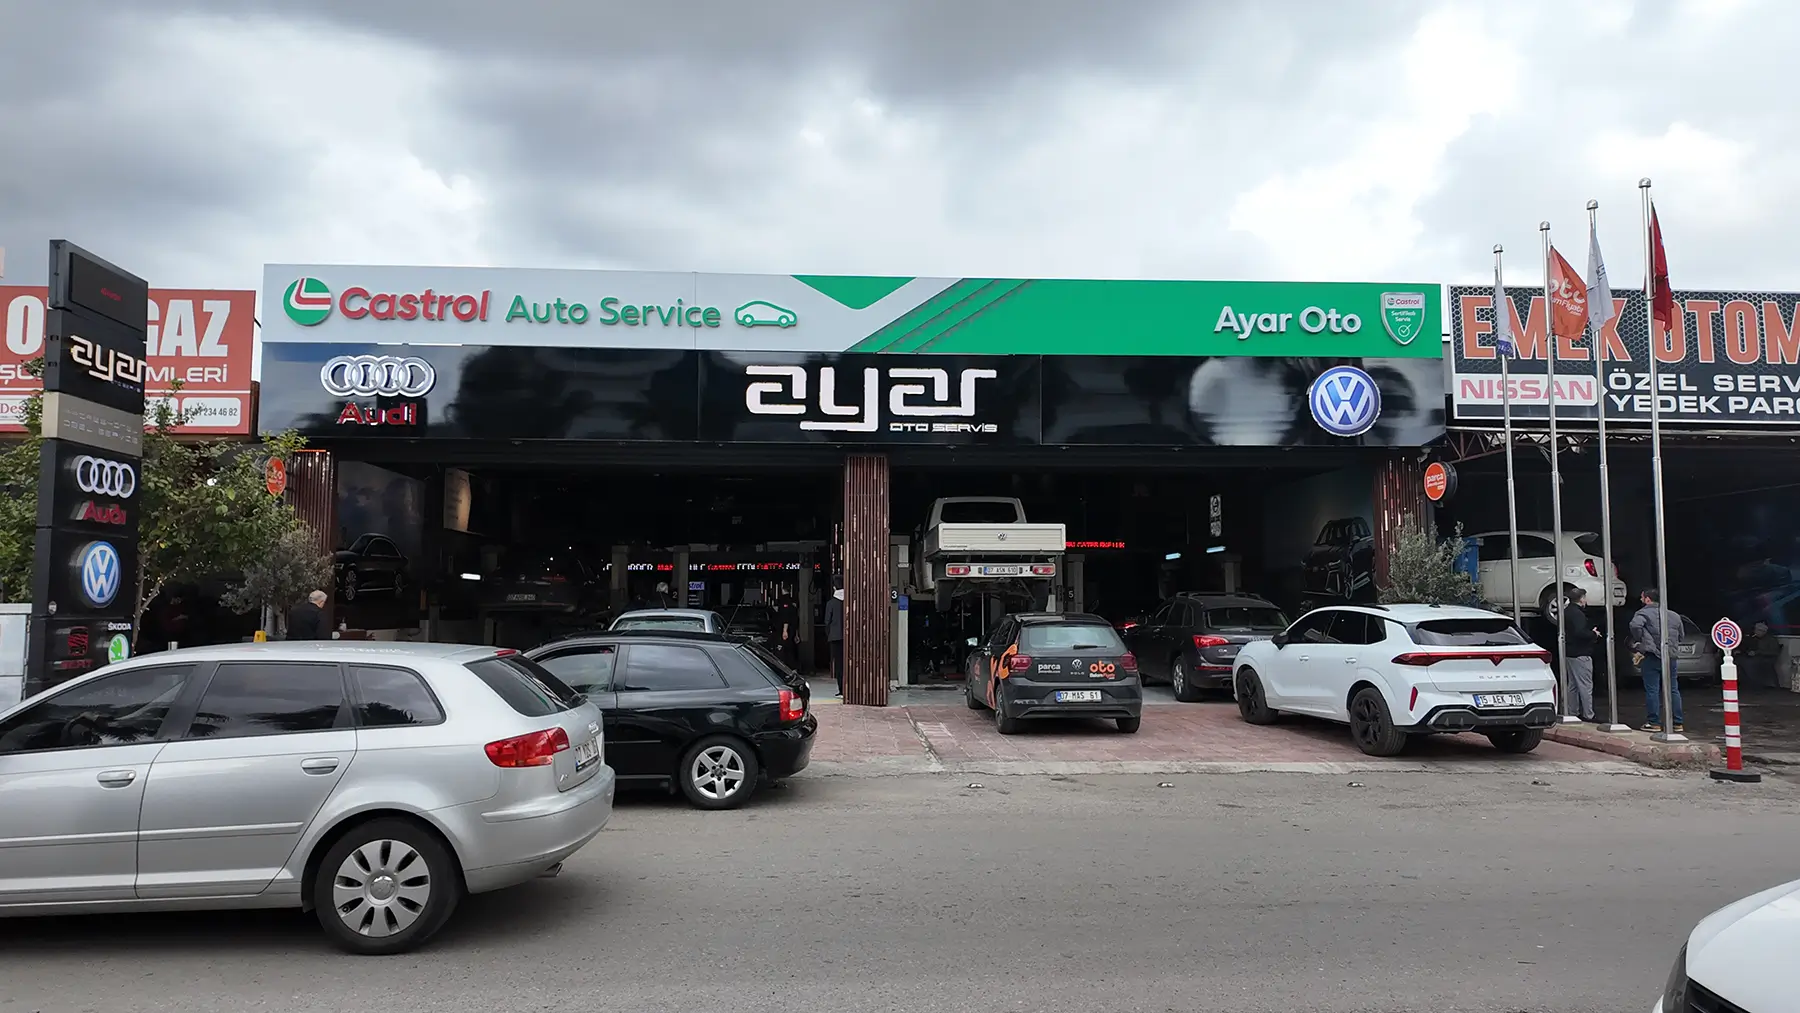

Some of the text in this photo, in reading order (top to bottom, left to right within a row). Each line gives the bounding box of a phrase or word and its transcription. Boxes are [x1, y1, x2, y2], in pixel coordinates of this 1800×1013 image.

[339, 287, 721, 327] Castrol Auto Service
[1214, 305, 1362, 340] Ayar Oto
[71, 335, 147, 383] ayar
[1461, 379, 1593, 400] NISSAN
[1608, 368, 1698, 392] ÖZEL
[745, 365, 998, 432] ayar
[1609, 394, 1800, 416] YEDEK PAR
[203, 407, 217, 416] 234
[219, 407, 227, 416] 46
[228, 407, 238, 416] 82
[336, 401, 417, 426] Audi
[889, 422, 929, 432] OTO
[82, 500, 127, 525] Audi
[891, 590, 898, 599] 3
[1089, 660, 1115, 672] oto
